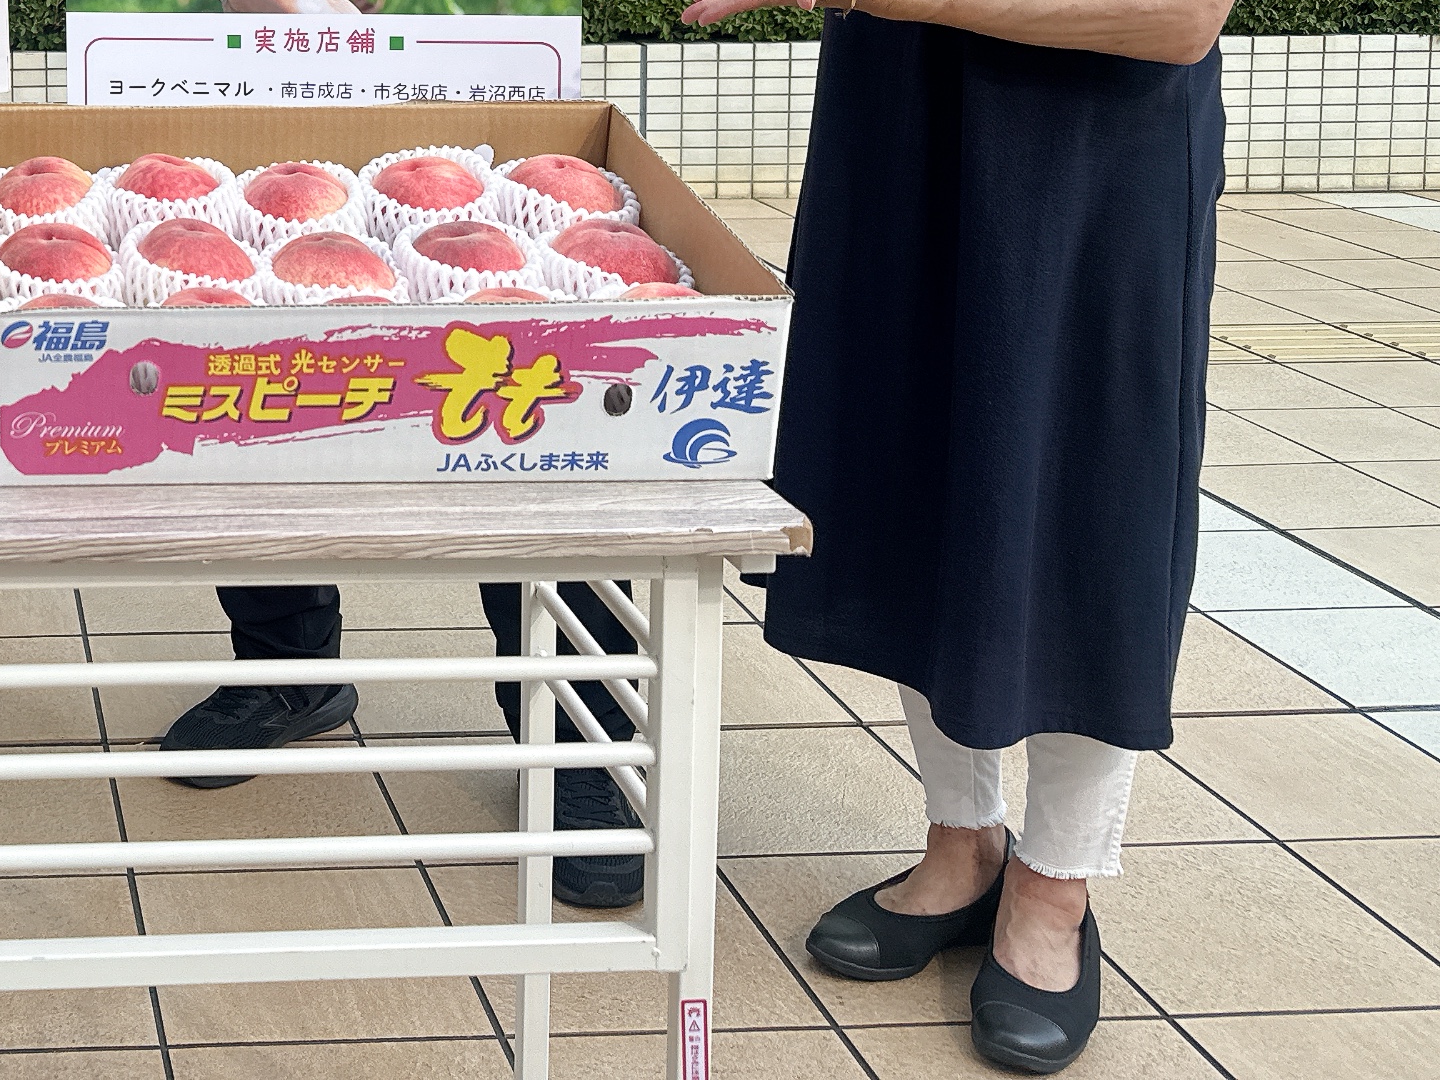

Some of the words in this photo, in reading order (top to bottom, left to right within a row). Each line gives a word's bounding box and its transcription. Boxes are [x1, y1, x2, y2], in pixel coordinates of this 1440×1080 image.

[254, 26, 377, 55] 実施店舗
[108, 78, 255, 98] ヨークベニマル
[33, 320, 110, 351] 福島
[38, 353, 94, 363] JA全農福島
[415, 328, 579, 441] もも
[649, 358, 775, 415] 伊達
[161, 376, 395, 423] ミスピーチ
[9, 411, 125, 440] Premium
[44, 439, 123, 456] プレミアム
[436, 452, 610, 474] JAふくしま未来
